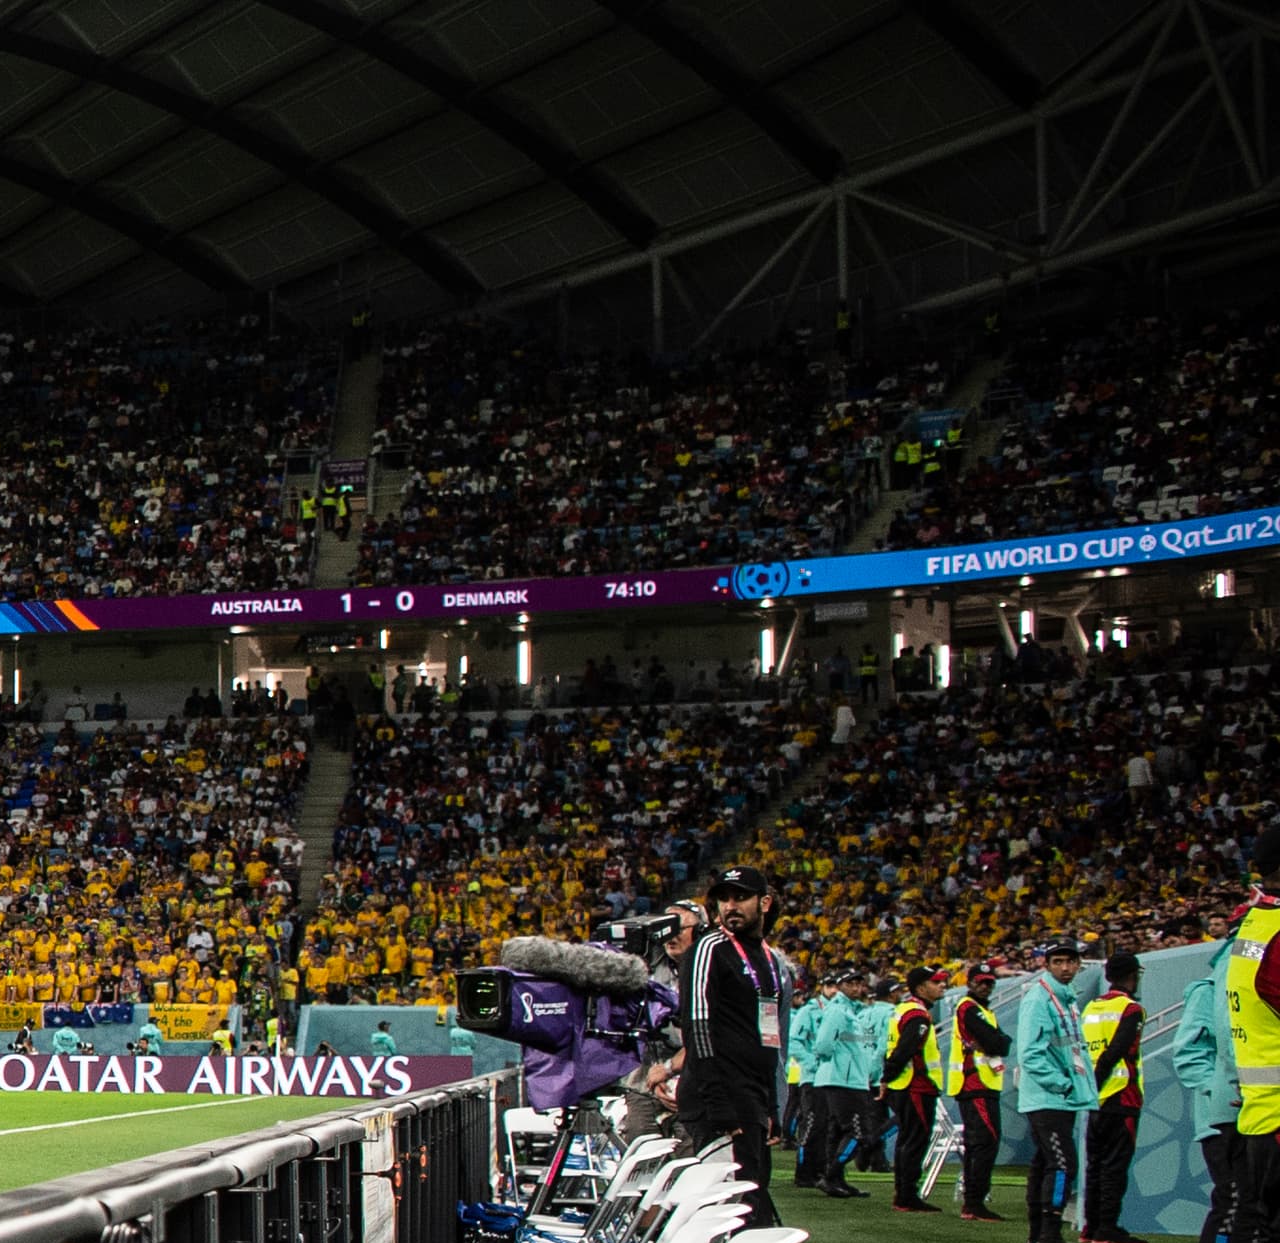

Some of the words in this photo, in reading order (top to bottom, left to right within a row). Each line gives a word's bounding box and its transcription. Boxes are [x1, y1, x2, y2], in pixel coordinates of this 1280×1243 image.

[928, 552, 981, 575] FIFA
[986, 543, 1077, 569] WORLD
[1083, 536, 1134, 559] CUP
[212, 598, 302, 615] AUSTRALIA
[397, 592, 414, 611] 0
[444, 589, 528, 608] DENMARK
[605, 580, 656, 598] 74:10
[188, 1055, 414, 1098] AIRWAYS
